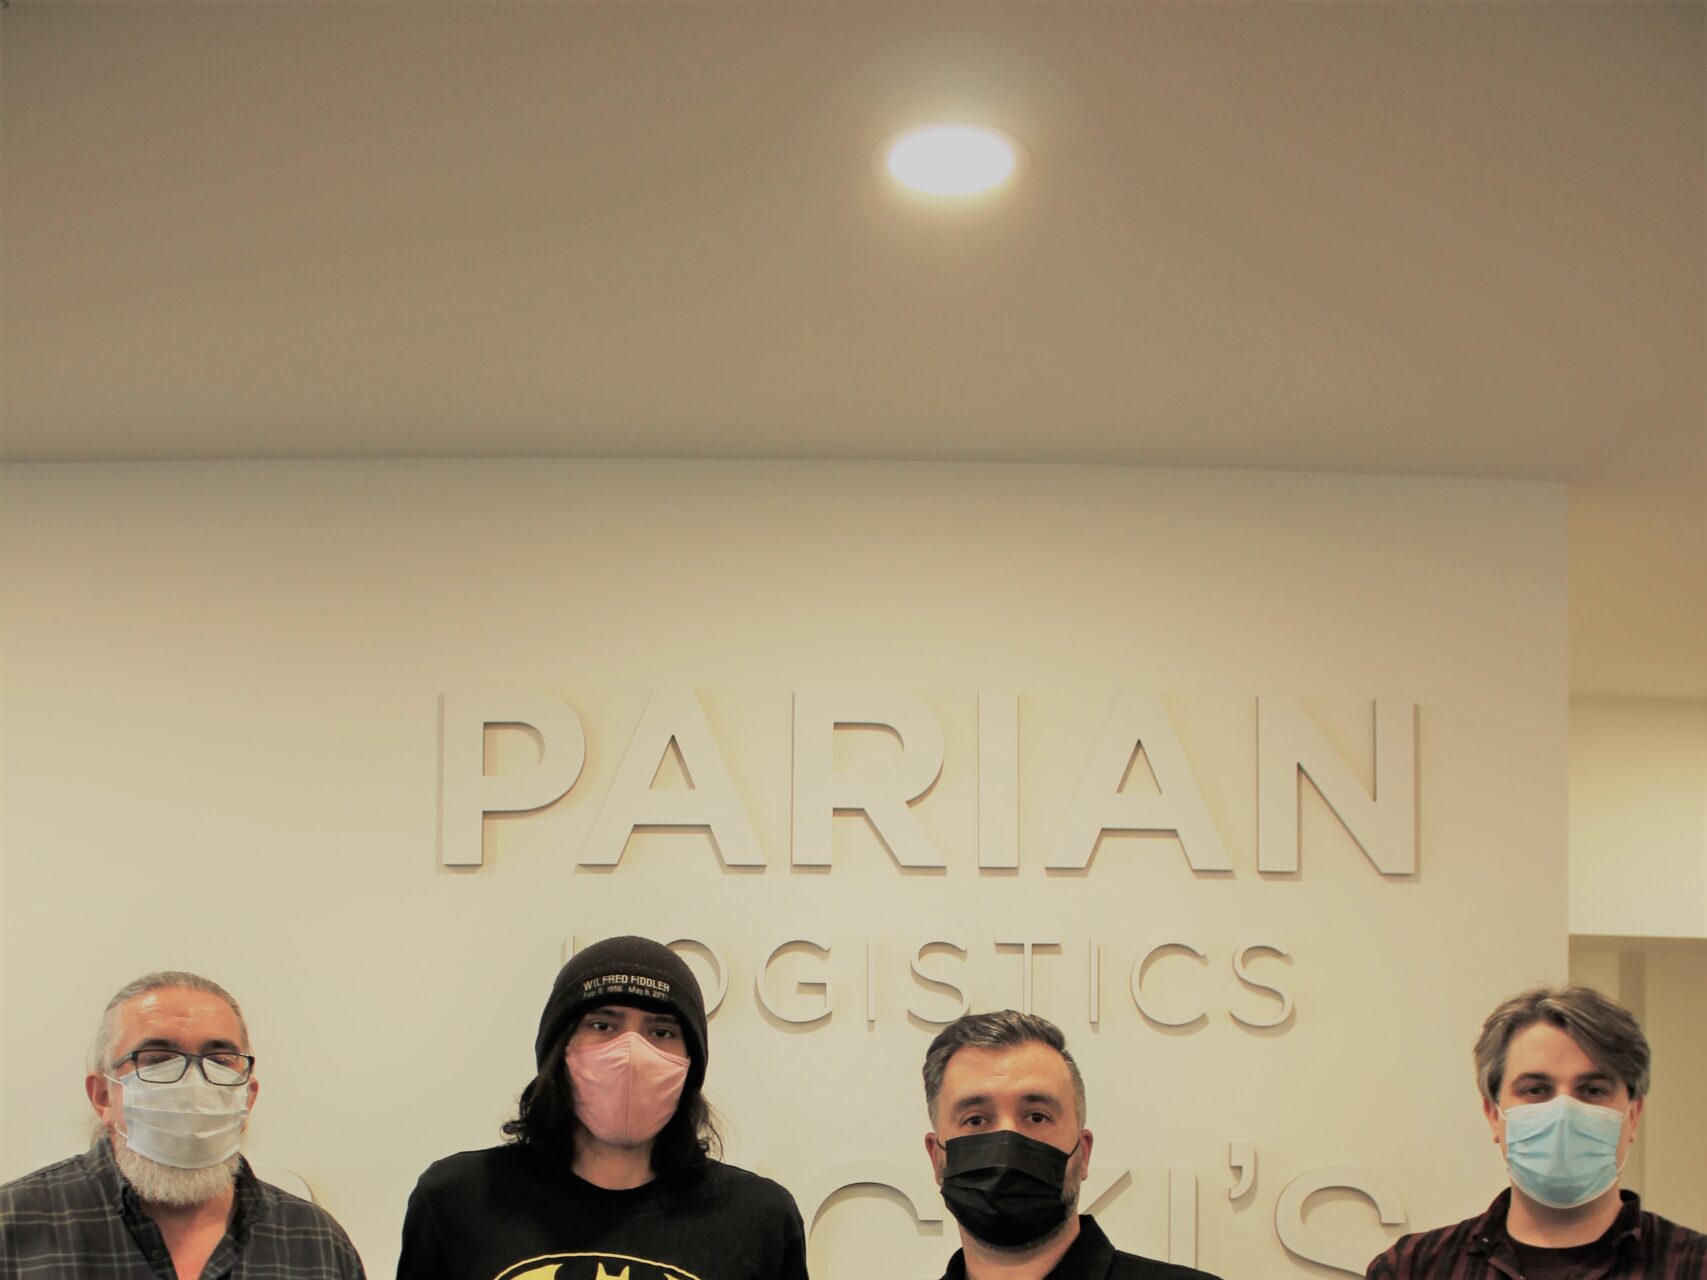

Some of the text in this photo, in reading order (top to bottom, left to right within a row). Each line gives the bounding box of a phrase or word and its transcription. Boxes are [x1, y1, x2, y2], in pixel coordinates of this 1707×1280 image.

[443, 684, 1416, 876] PARIAN
[561, 932, 1294, 1028] OGISTICS
[583, 975, 670, 992] WILFRED FIDDLER
